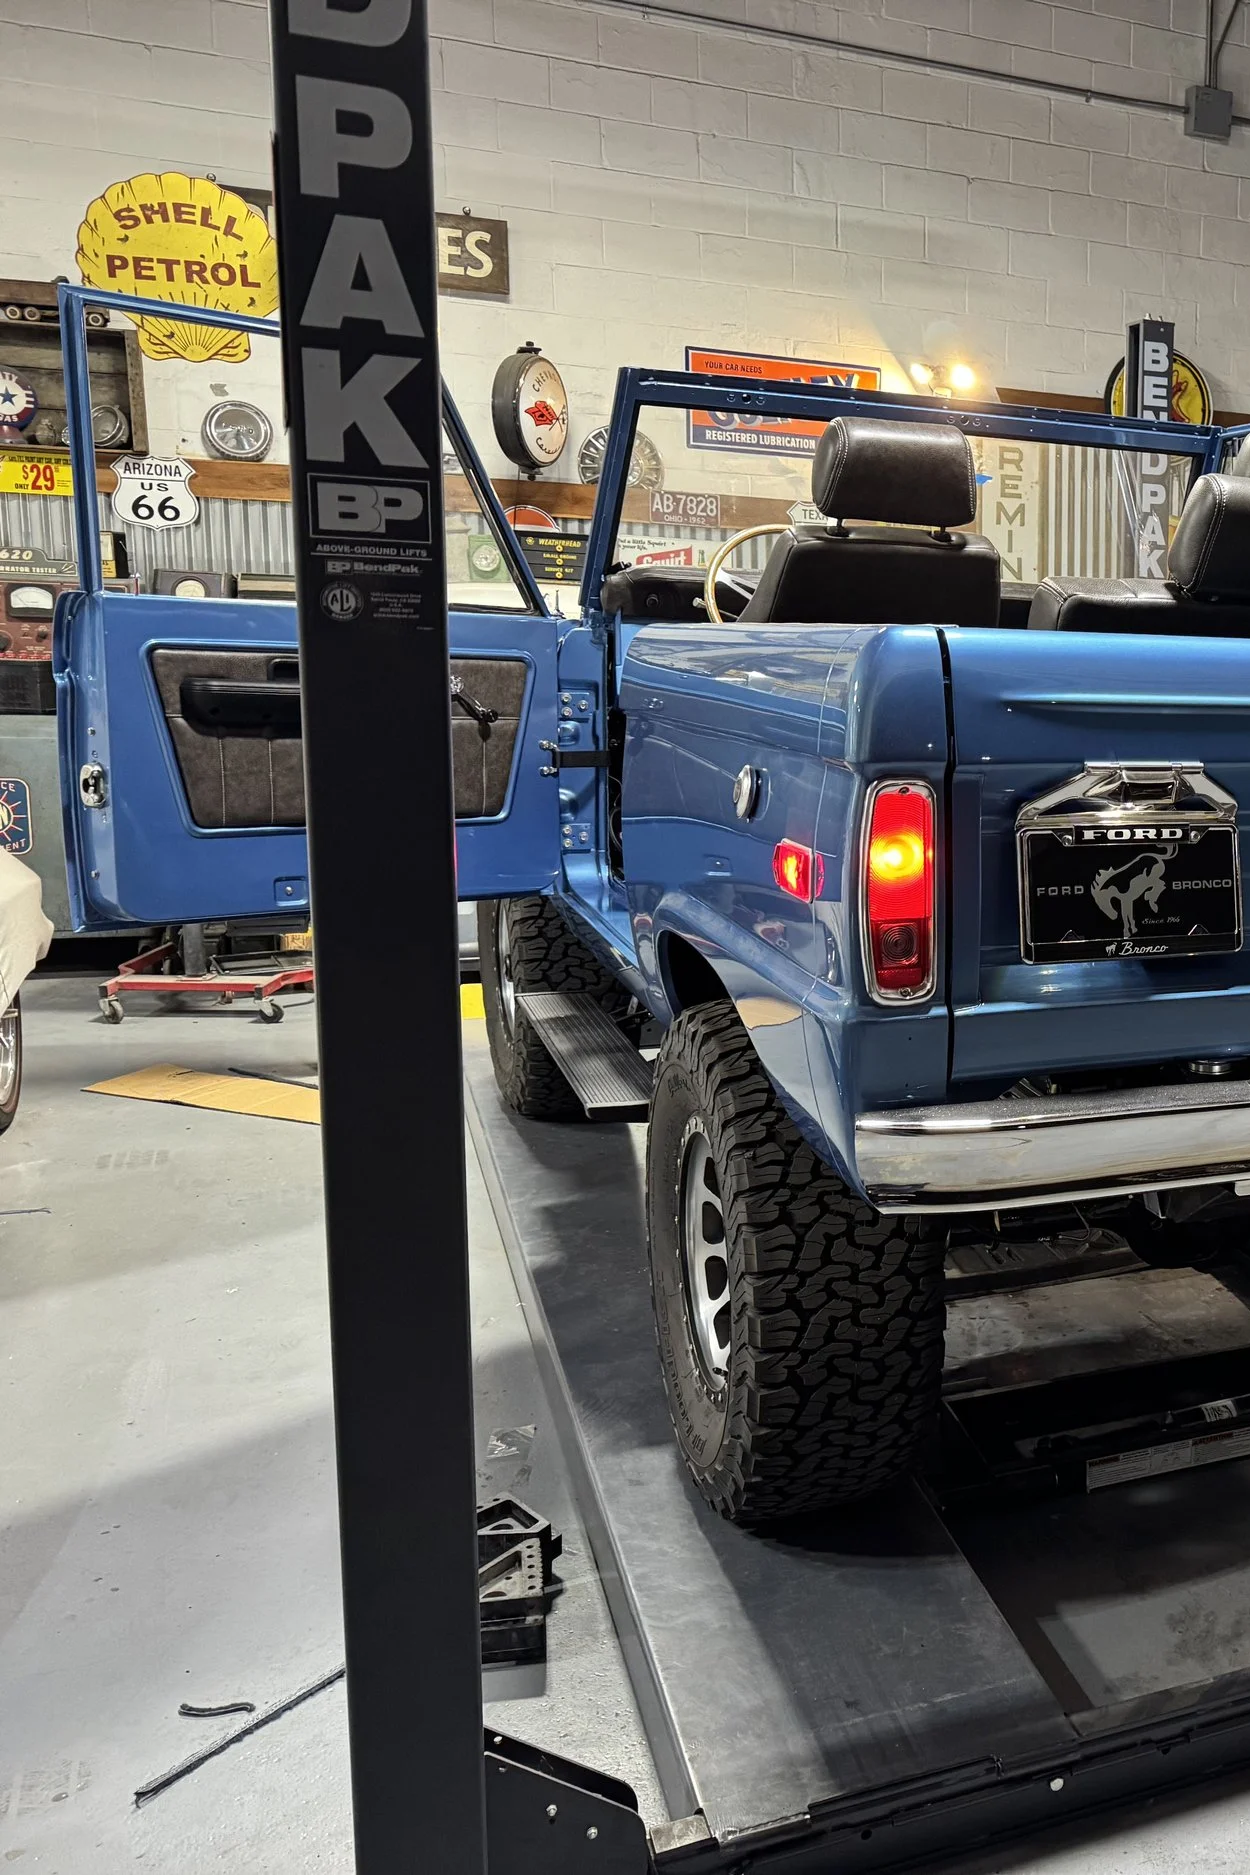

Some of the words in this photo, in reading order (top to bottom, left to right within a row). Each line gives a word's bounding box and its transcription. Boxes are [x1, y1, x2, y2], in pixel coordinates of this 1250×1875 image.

[113, 201, 243, 242] SHELL
[106, 254, 261, 288] PETROL
[704, 360, 723, 370] YOUR
[725, 363, 739, 371] CAR
[740, 364, 762, 374] NEEDS
[706, 429, 758, 445] REGISTERED
[759, 434, 815, 450] LUBRICATION
[124, 462, 182, 477] ARIZONA
[141, 482, 169, 492] US
[132, 494, 180, 521] 66
[317, 482, 423, 533] BP
[664, 515, 682, 524] OHIO
[539, 538, 582, 547] WEATHERHEAD
[316, 543, 397, 556] ABOVE-GROUND
[400, 549, 428, 558] LIFTS
[353, 561, 419, 574] BendPak
[1081, 828, 1183, 841] FORD
[1037, 885, 1084, 897] FORD
[1172, 879, 1232, 890] BRONCO
[1142, 917, 1164, 925] Since
[1118, 942, 1169, 955] Bronco
